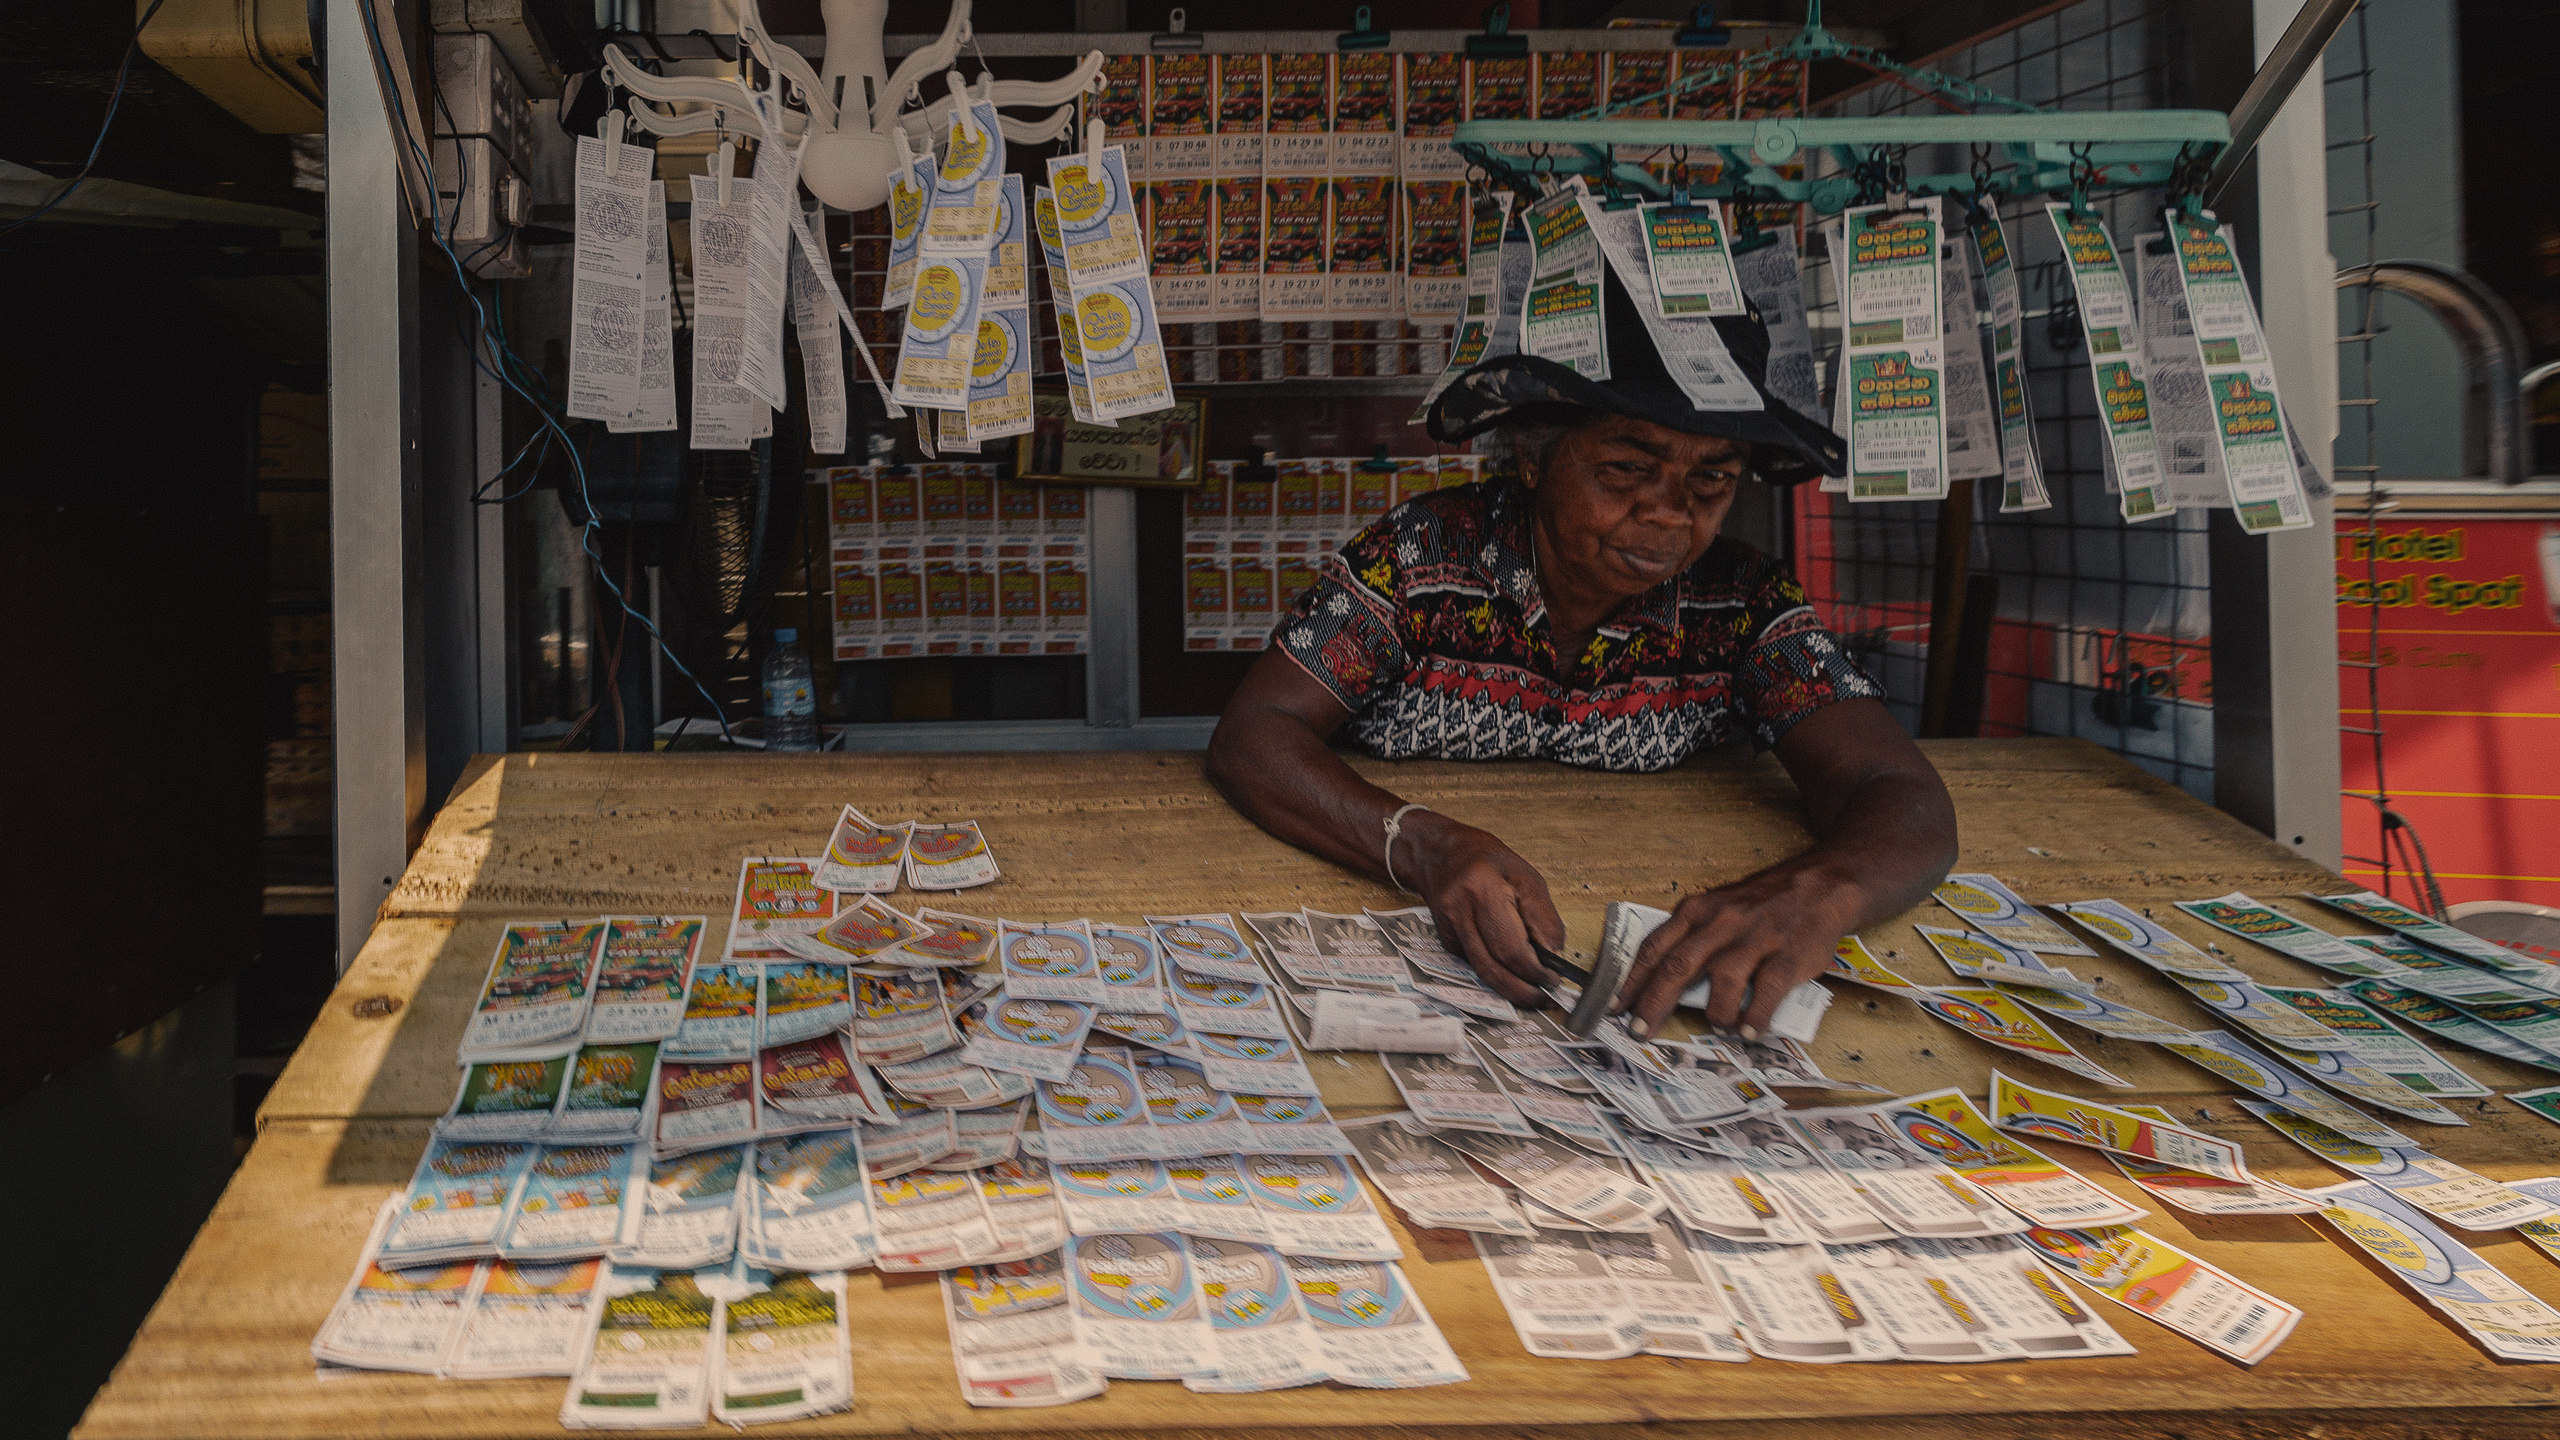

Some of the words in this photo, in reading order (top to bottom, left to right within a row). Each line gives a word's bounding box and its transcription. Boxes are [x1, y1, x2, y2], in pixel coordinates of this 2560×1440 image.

[1158, 77, 1178, 85] CAR
[1180, 76, 1205, 84] PLUS
[1225, 74, 1246, 83] CAR
[1296, 74, 1322, 82] PLUS
[1342, 74, 1362, 82] CAR
[1411, 79, 1432, 87] CAR
[1433, 78, 1458, 87] PLUS
[1477, 77, 1498, 85] CAR
[1499, 76, 1524, 84] PLUS
[1224, 217, 1245, 225] CAR
[1274, 217, 1293, 225] CAR
[1294, 216, 1320, 224] PLUS
[1339, 215, 1359, 223] CAR
[1414, 219, 1435, 227] CAR
[1435, 219, 1459, 227] PLUS
[2351, 527, 2466, 563] Hotel
[2421, 573, 2526, 616] Spot
